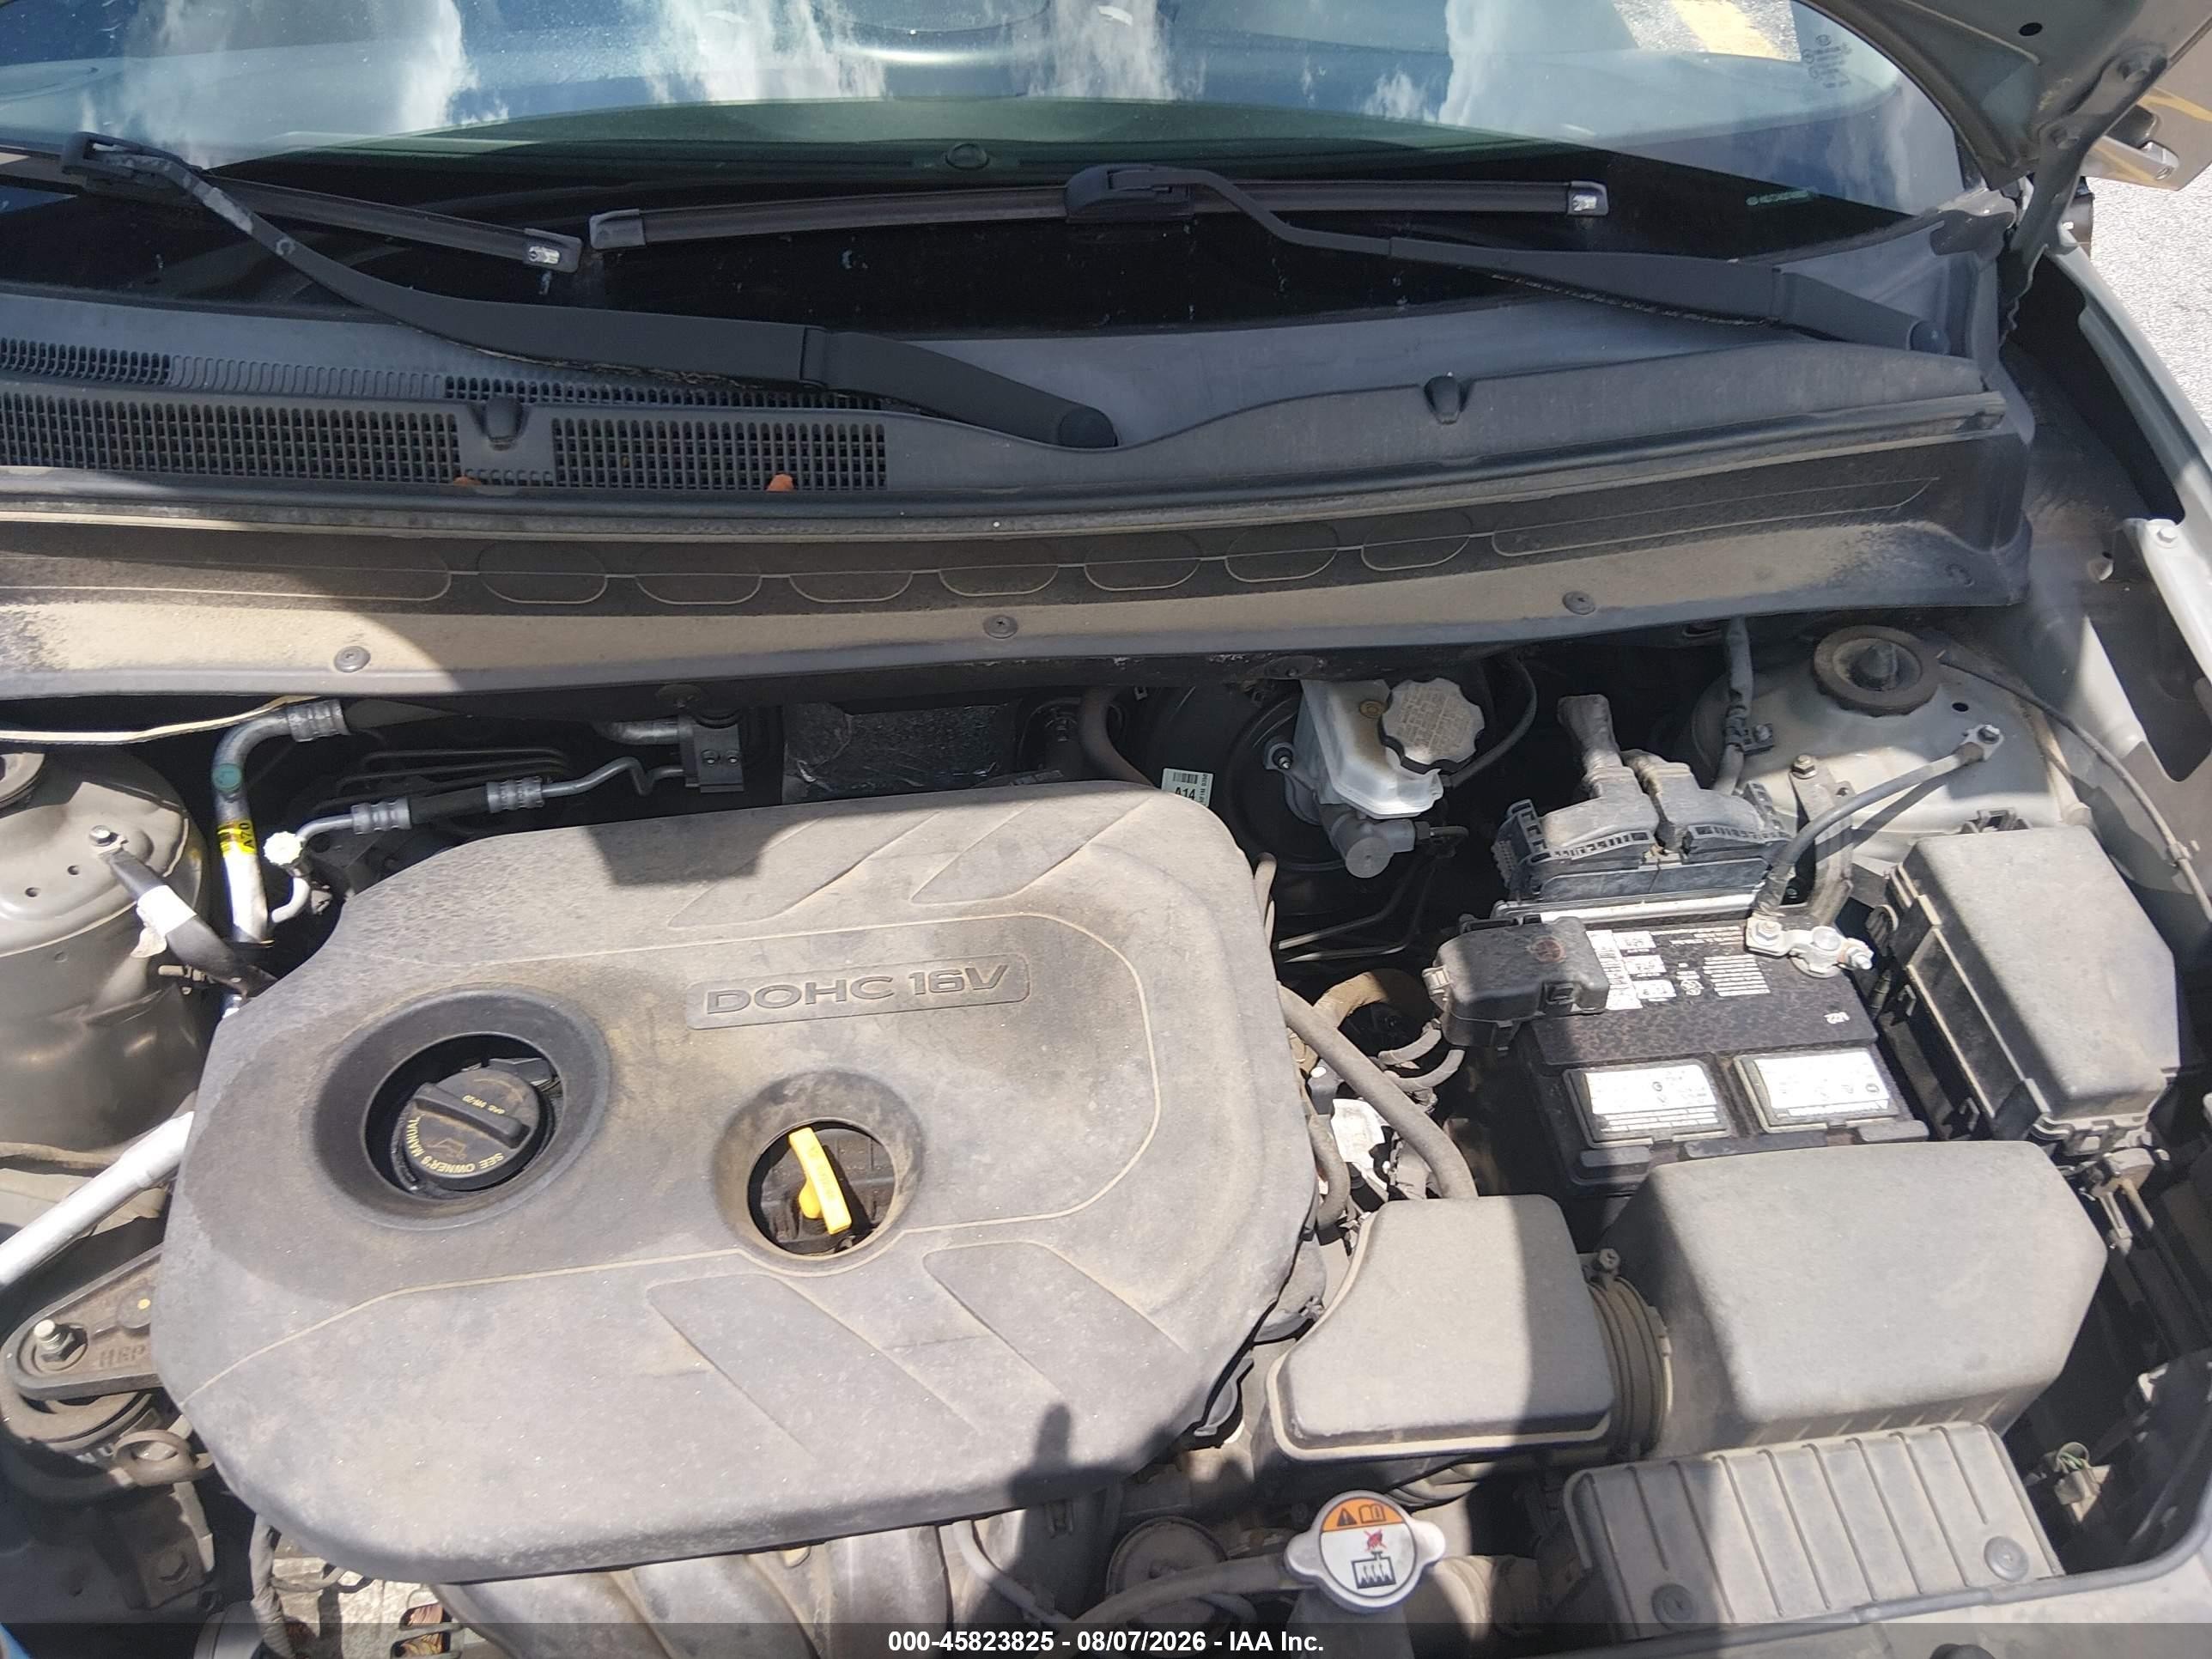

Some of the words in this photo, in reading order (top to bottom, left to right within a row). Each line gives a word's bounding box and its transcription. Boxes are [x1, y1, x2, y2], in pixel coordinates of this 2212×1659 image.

[240, 823, 255, 848] A70
[707, 975, 895, 1014] DOHC
[908, 964, 1008, 996] 16V
[406, 1116, 425, 1157] MANUAL
[420, 1156, 476, 1174] OWNER'S
[479, 1152, 505, 1170] SEE
